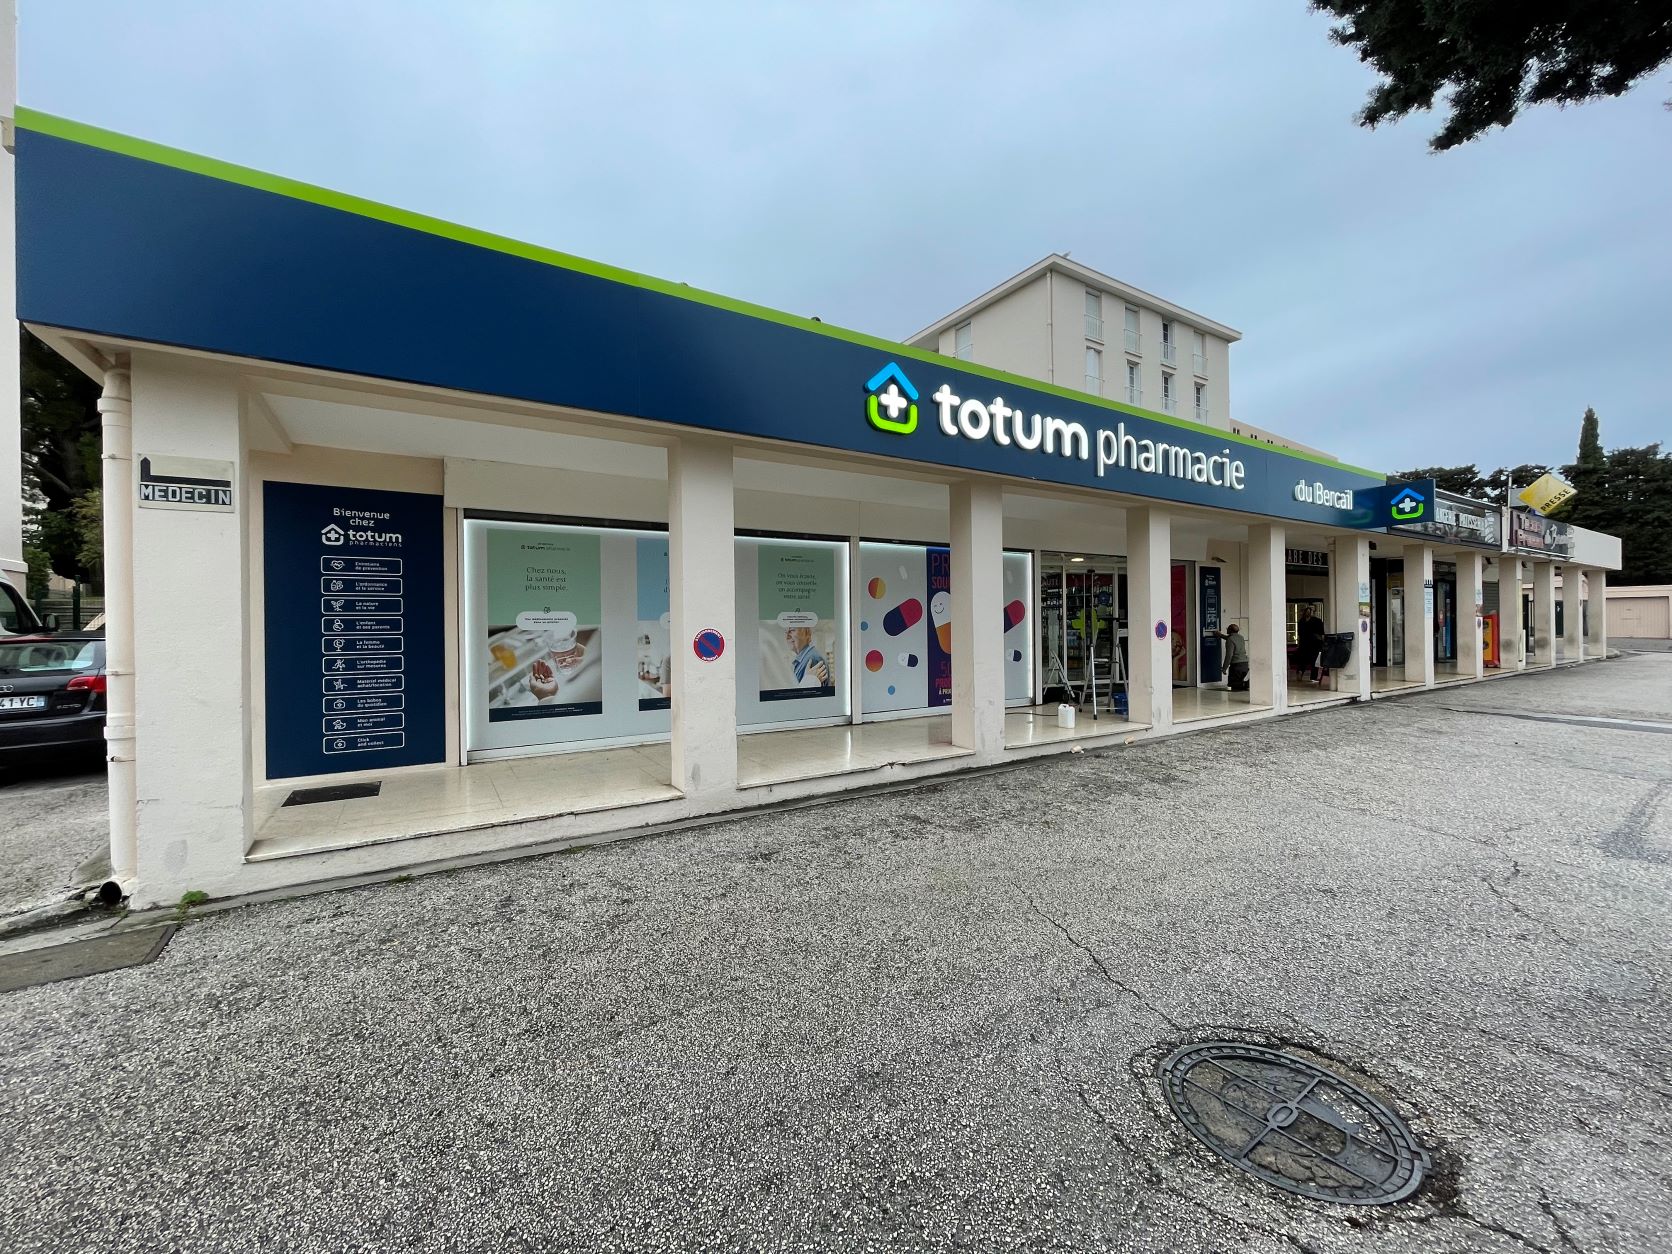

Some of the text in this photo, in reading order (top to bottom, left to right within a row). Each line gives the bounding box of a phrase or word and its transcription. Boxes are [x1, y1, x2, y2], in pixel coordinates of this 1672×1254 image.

[932, 384, 1245, 490] totum pharmacie
[140, 484, 231, 505] MEDECIN
[1294, 479, 1353, 510] du Bercail
[1540, 488, 1571, 512] PRESSE
[333, 507, 390, 519] Bienvenue
[349, 518, 375, 527] chez
[347, 529, 402, 543] totum
[526, 566, 545, 574] Chez
[526, 574, 533, 582] la
[525, 583, 541, 592] plus
